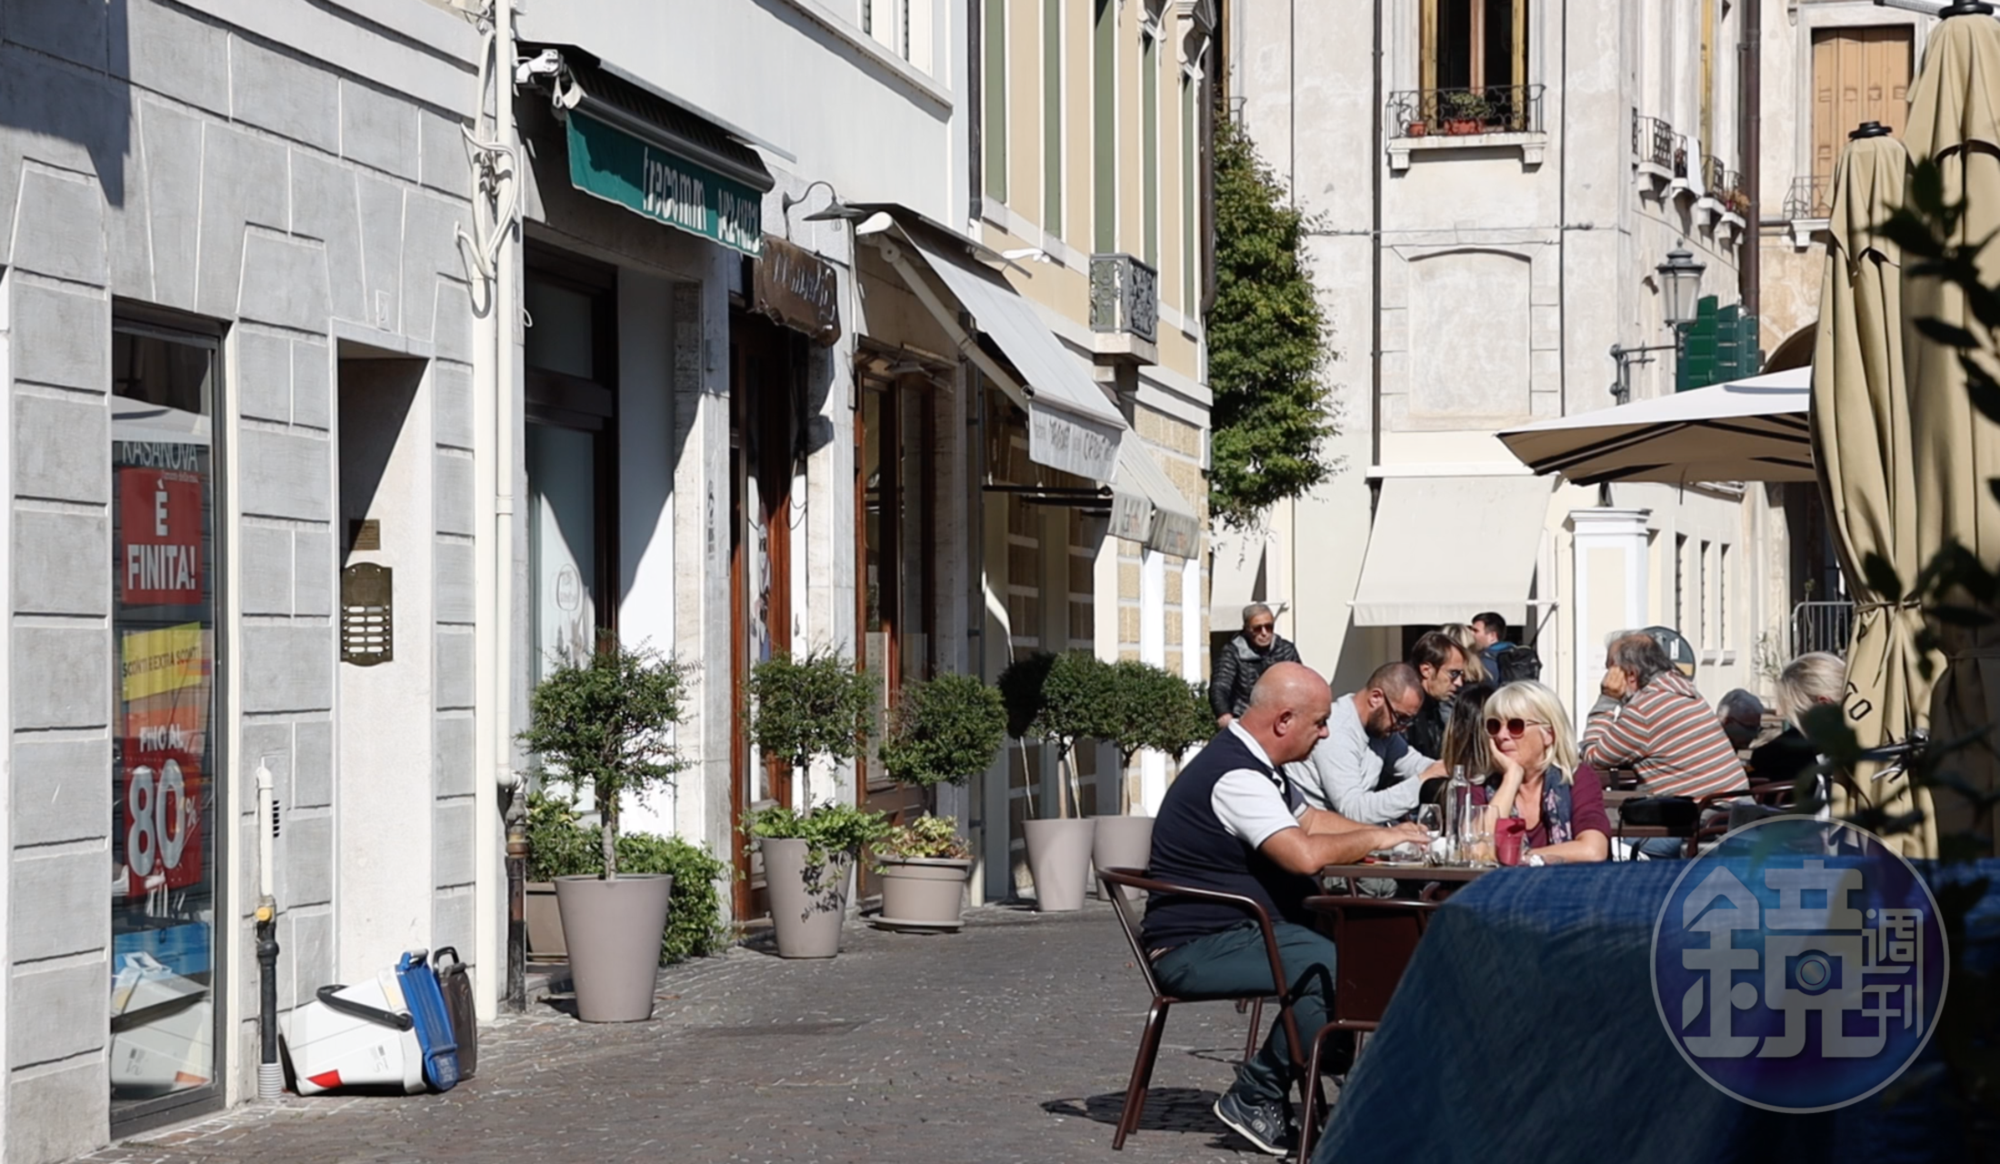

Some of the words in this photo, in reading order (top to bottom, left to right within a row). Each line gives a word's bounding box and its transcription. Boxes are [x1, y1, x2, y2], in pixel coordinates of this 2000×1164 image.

[122, 441, 199, 472] KASANOVA
[155, 479, 168, 536] È
[127, 544, 195, 590] FINITA!
